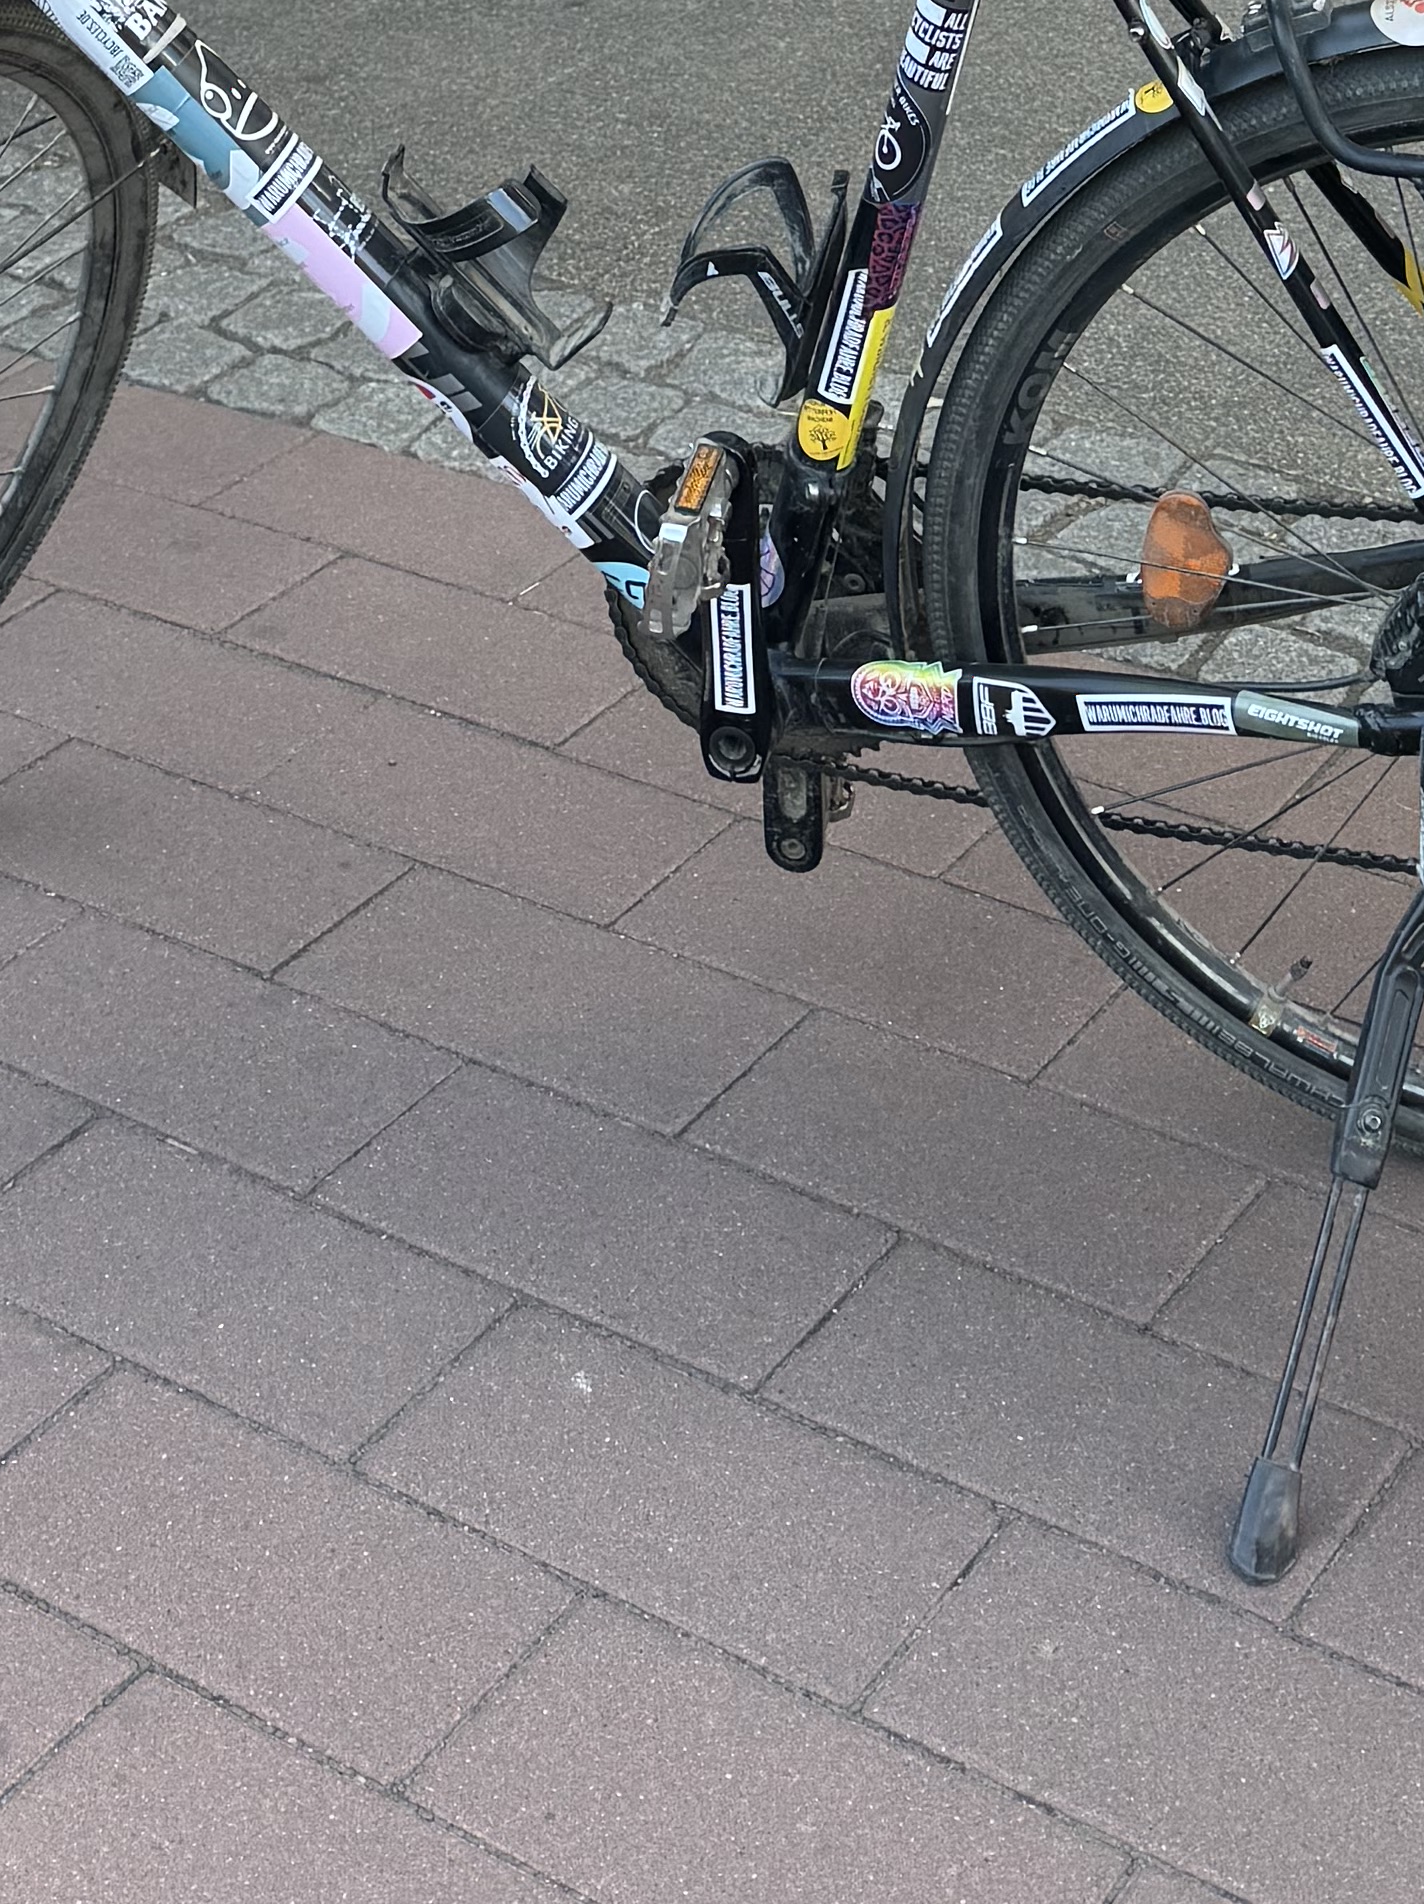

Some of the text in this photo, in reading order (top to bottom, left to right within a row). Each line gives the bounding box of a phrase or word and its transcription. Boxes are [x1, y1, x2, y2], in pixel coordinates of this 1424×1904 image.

[944, 12, 970, 31] ALL
[899, 49, 950, 92] EAUTIFUL
[928, 50, 958, 71] ARE
[543, 415, 580, 471] BIKING
[1247, 703, 1344, 739] EIGHTSHOT
[1217, 1030, 1349, 1110] CHWALBE
